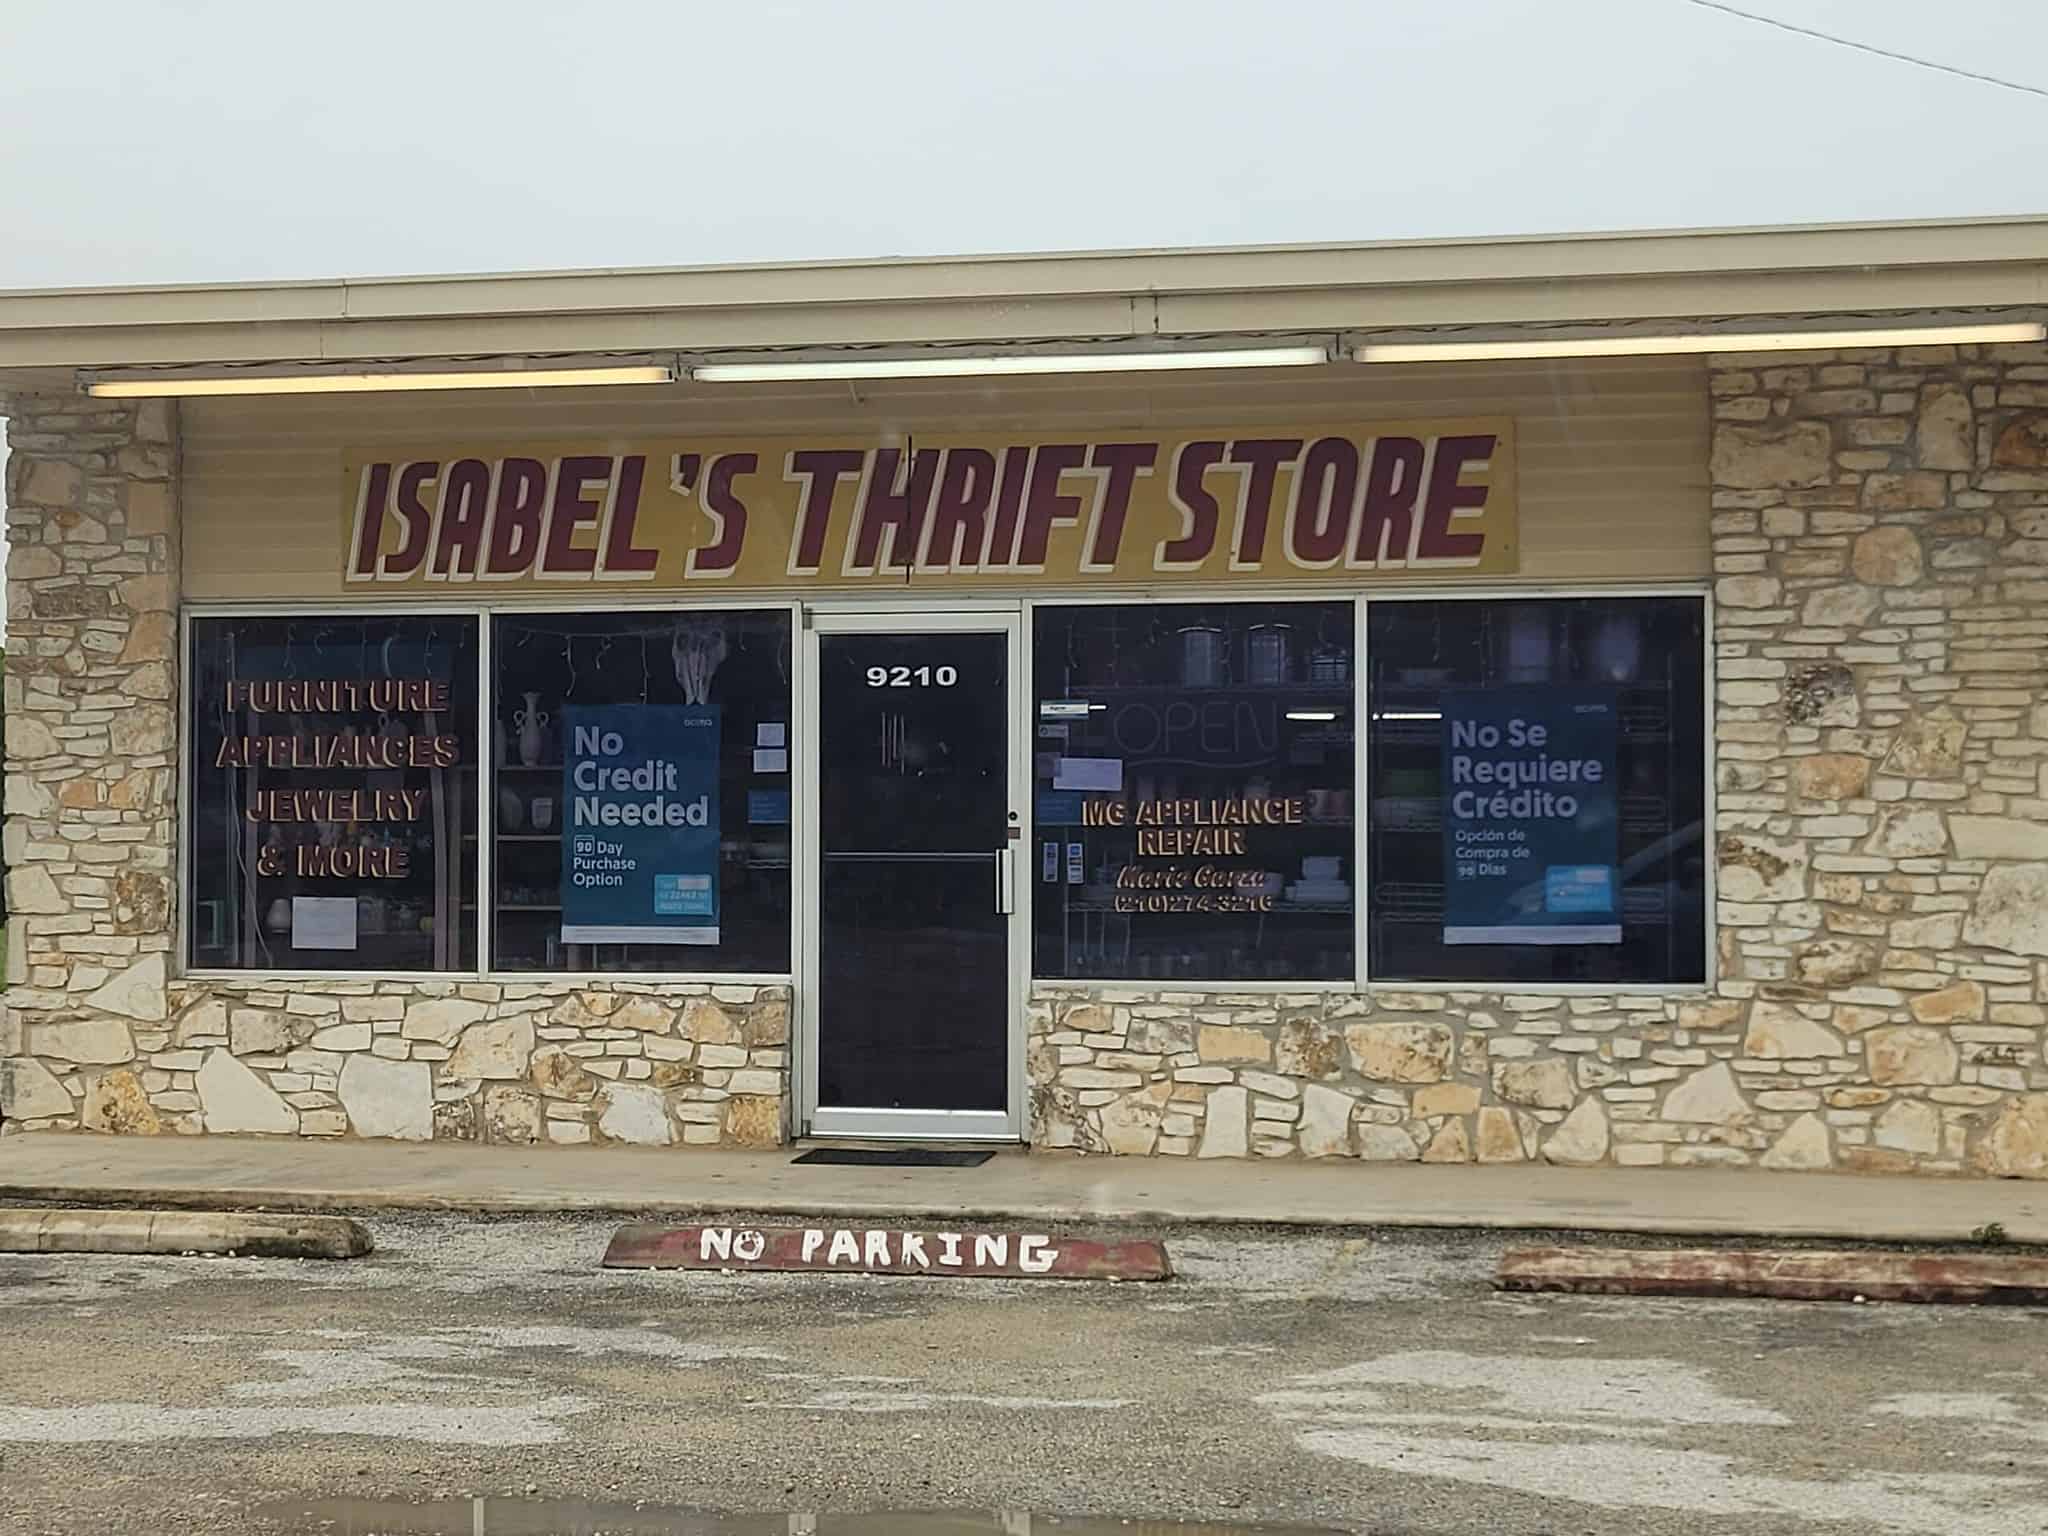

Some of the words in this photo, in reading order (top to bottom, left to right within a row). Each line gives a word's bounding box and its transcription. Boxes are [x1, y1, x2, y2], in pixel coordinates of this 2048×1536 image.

[346, 452, 758, 582] ISABEL'S
[783, 443, 1159, 577] THRIFT
[1153, 434, 1497, 571] STORE
[866, 666, 957, 686] 9210
[226, 679, 450, 713] FURNITURE
[574, 726, 624, 756] No
[1113, 701, 1279, 753] OPEN
[1452, 720, 1500, 748] No
[1508, 719, 1547, 748] Se
[215, 735, 459, 768] APPLIANCES
[573, 760, 678, 791] Credit
[1452, 754, 1603, 789] Requiere
[246, 789, 428, 823] JEWELRY
[573, 796, 708, 826] Needed
[1134, 799, 1302, 825] APPLIANCE
[1452, 790, 1578, 819] Crédito
[576, 841, 593, 853] 90
[597, 841, 623, 856] Day
[1138, 829, 1247, 855] REPAIR
[1507, 829, 1526, 841] de
[256, 846, 284, 877] &
[297, 844, 410, 878] MORE
[573, 857, 636, 870] Purchase
[1455, 847, 1509, 860] Compra
[1512, 846, 1531, 858] de
[573, 872, 623, 888] Option
[700, 1227, 766, 1261] NO
[801, 1229, 1059, 1273] PARKING
